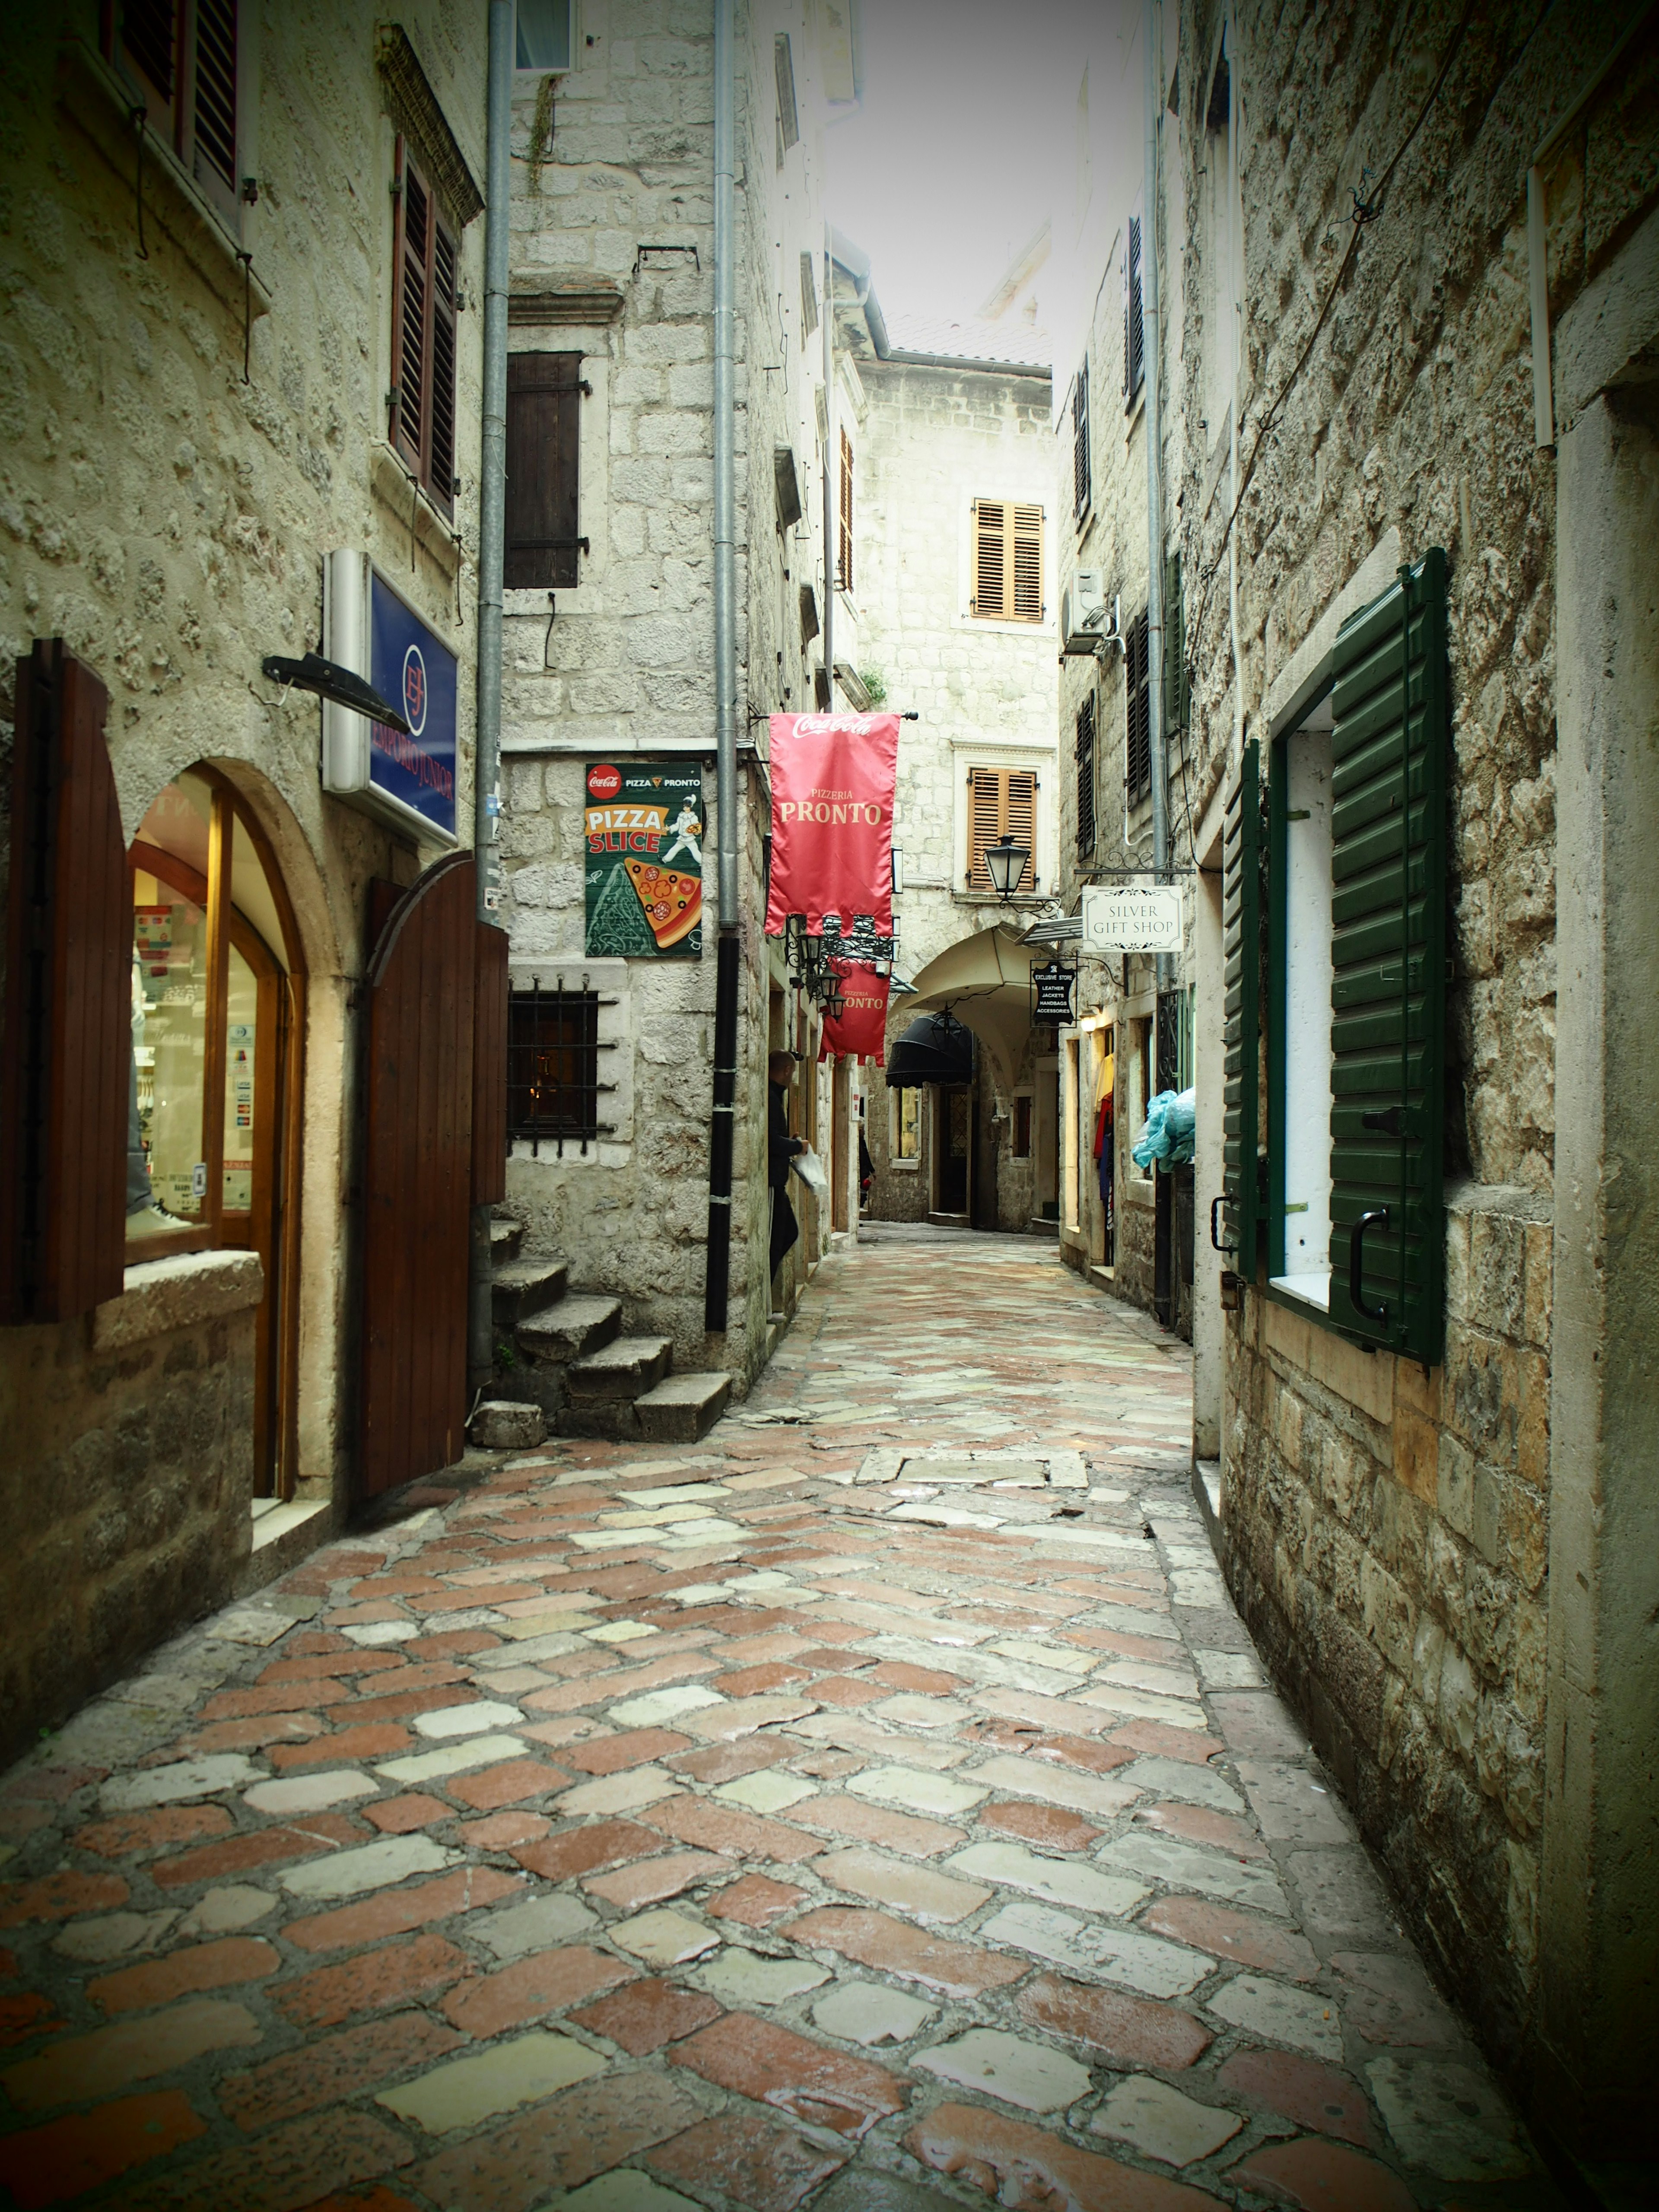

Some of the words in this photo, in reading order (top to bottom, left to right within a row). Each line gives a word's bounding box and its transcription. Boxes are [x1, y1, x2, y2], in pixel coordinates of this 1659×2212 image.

[792, 714, 877, 738] Coca-Cola
[372, 720, 418, 775] EMPORIO
[419, 750, 453, 801] JUNIOR
[589, 776, 618, 787] Coca-Cola
[811, 788, 852, 799] PIZZERIA
[589, 810, 661, 830] PIZZA
[781, 801, 881, 825] PRONTO
[588, 830, 661, 854] SLICE
[1109, 906, 1158, 917] SILVER
[1094, 922, 1128, 934] GIFT
[1134, 922, 1173, 933] SHOP
[843, 997, 883, 1009] ONTO
